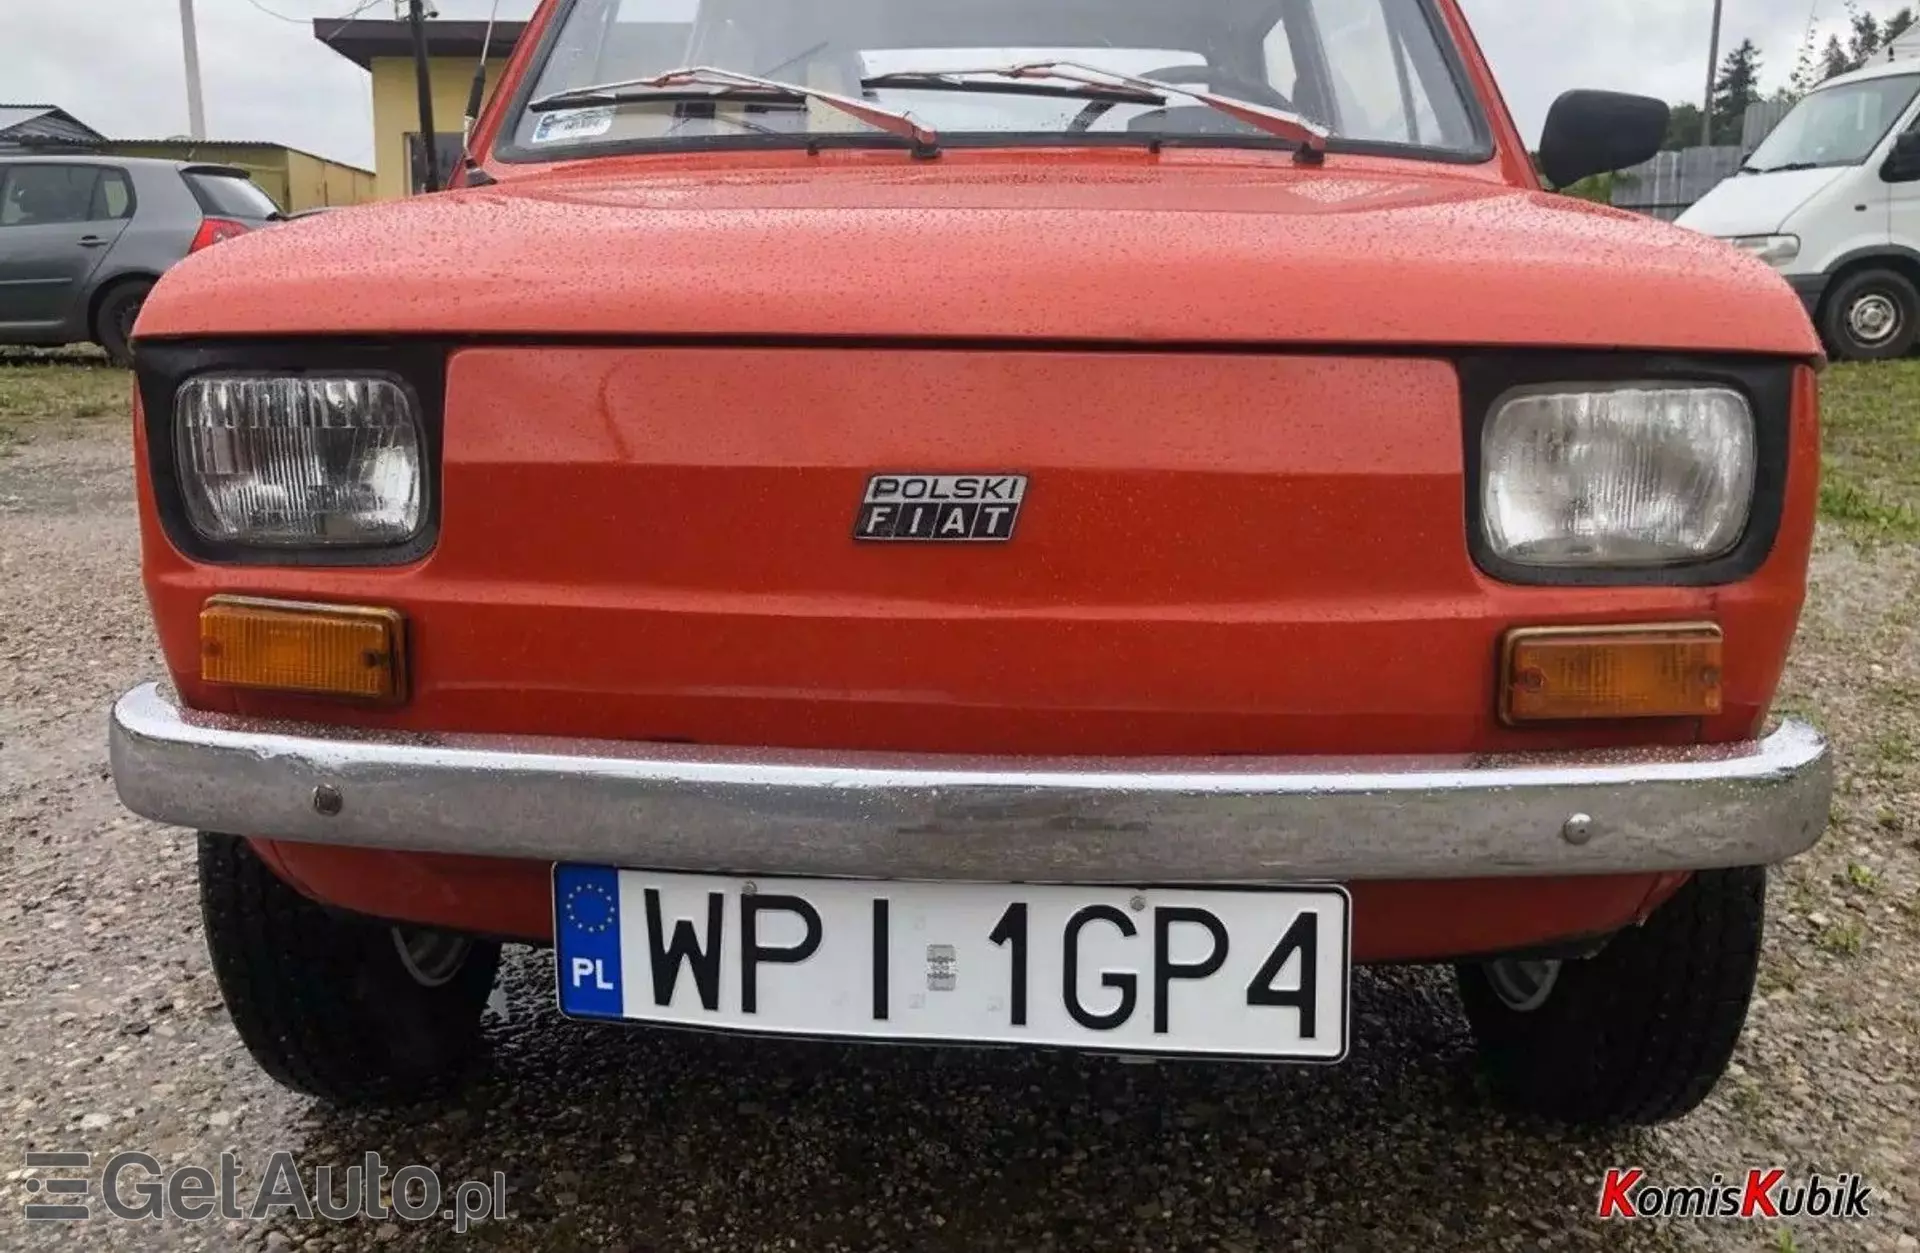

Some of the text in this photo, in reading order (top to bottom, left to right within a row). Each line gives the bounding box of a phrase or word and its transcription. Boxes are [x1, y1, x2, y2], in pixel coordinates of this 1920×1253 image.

[872, 478, 1019, 499] POLSKI
[865, 507, 1010, 534] FIAT
[571, 957, 614, 991] PL
[643, 888, 1318, 1038] WPI 1GP4
